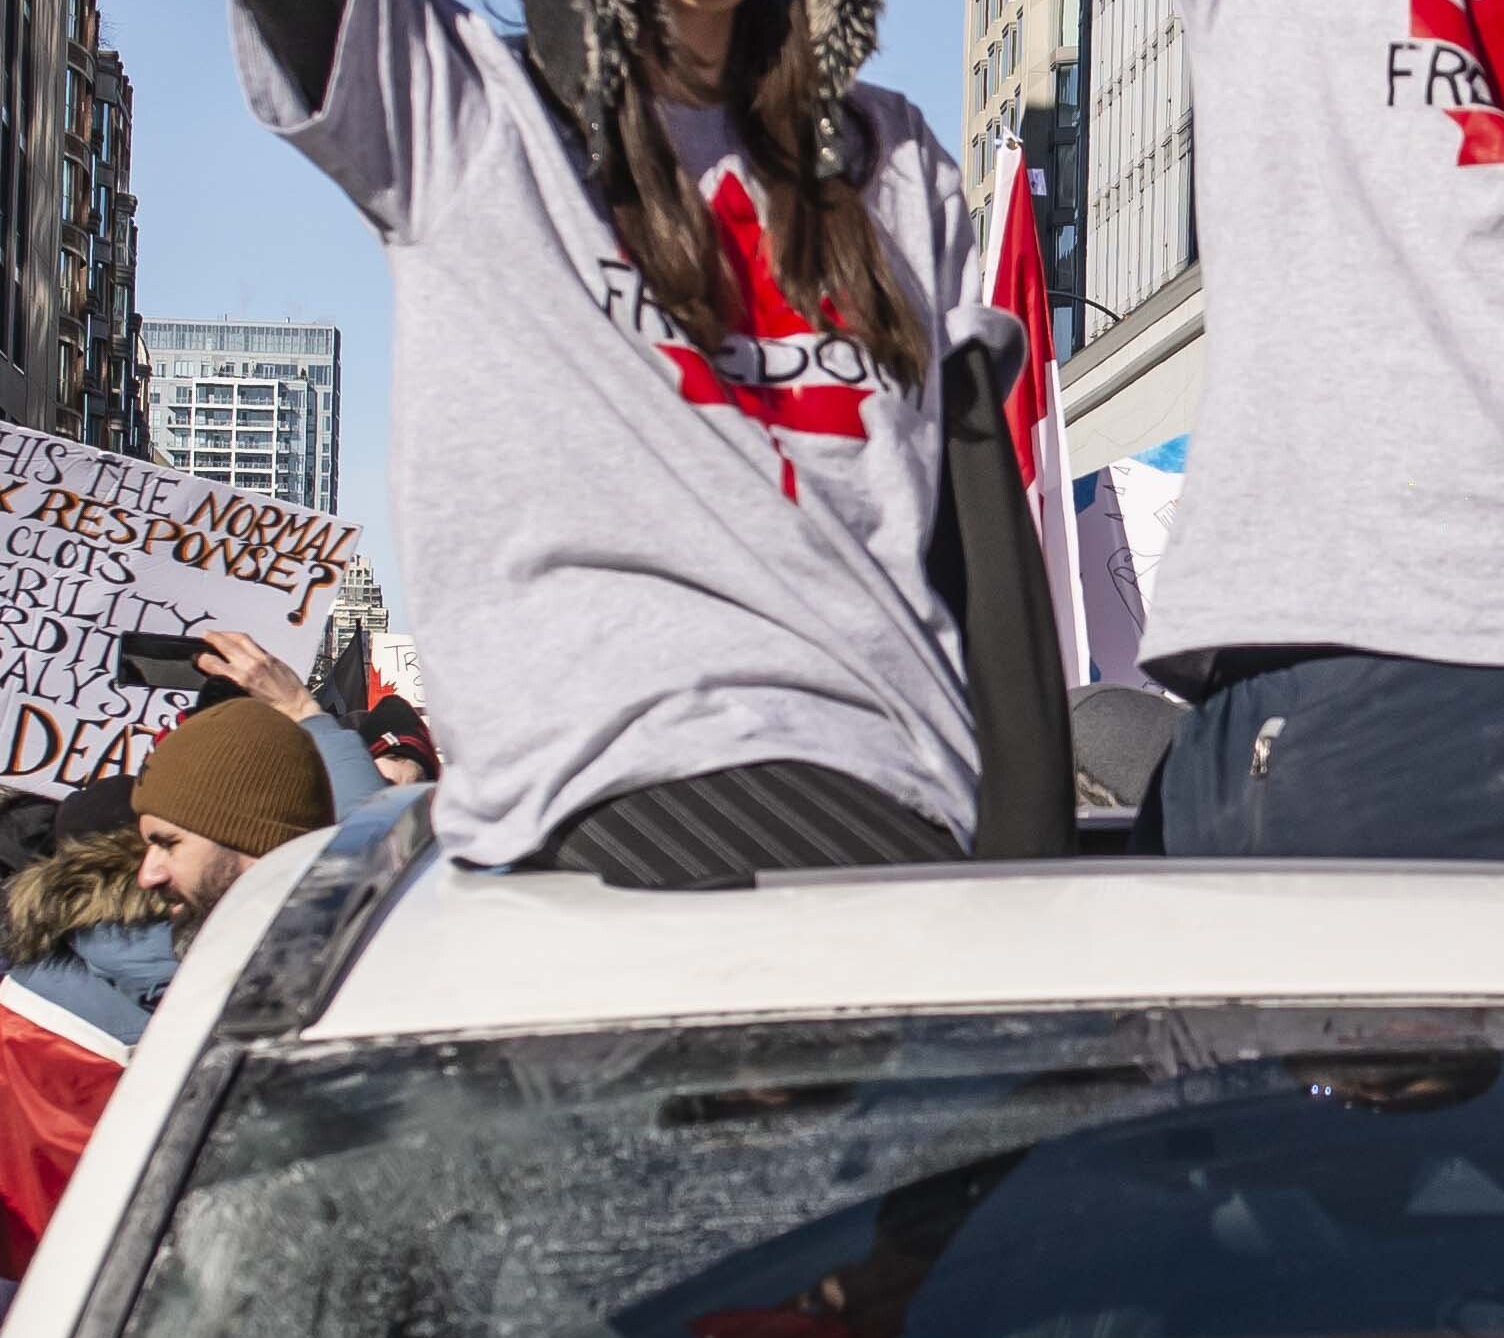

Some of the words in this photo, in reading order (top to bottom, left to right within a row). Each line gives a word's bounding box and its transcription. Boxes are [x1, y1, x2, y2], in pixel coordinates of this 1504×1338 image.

[6, 525, 138, 585] CLOTS
[24, 489, 346, 628] RESPONSE?
[81, 458, 183, 519] THE
[185, 489, 365, 567] NORMAL
